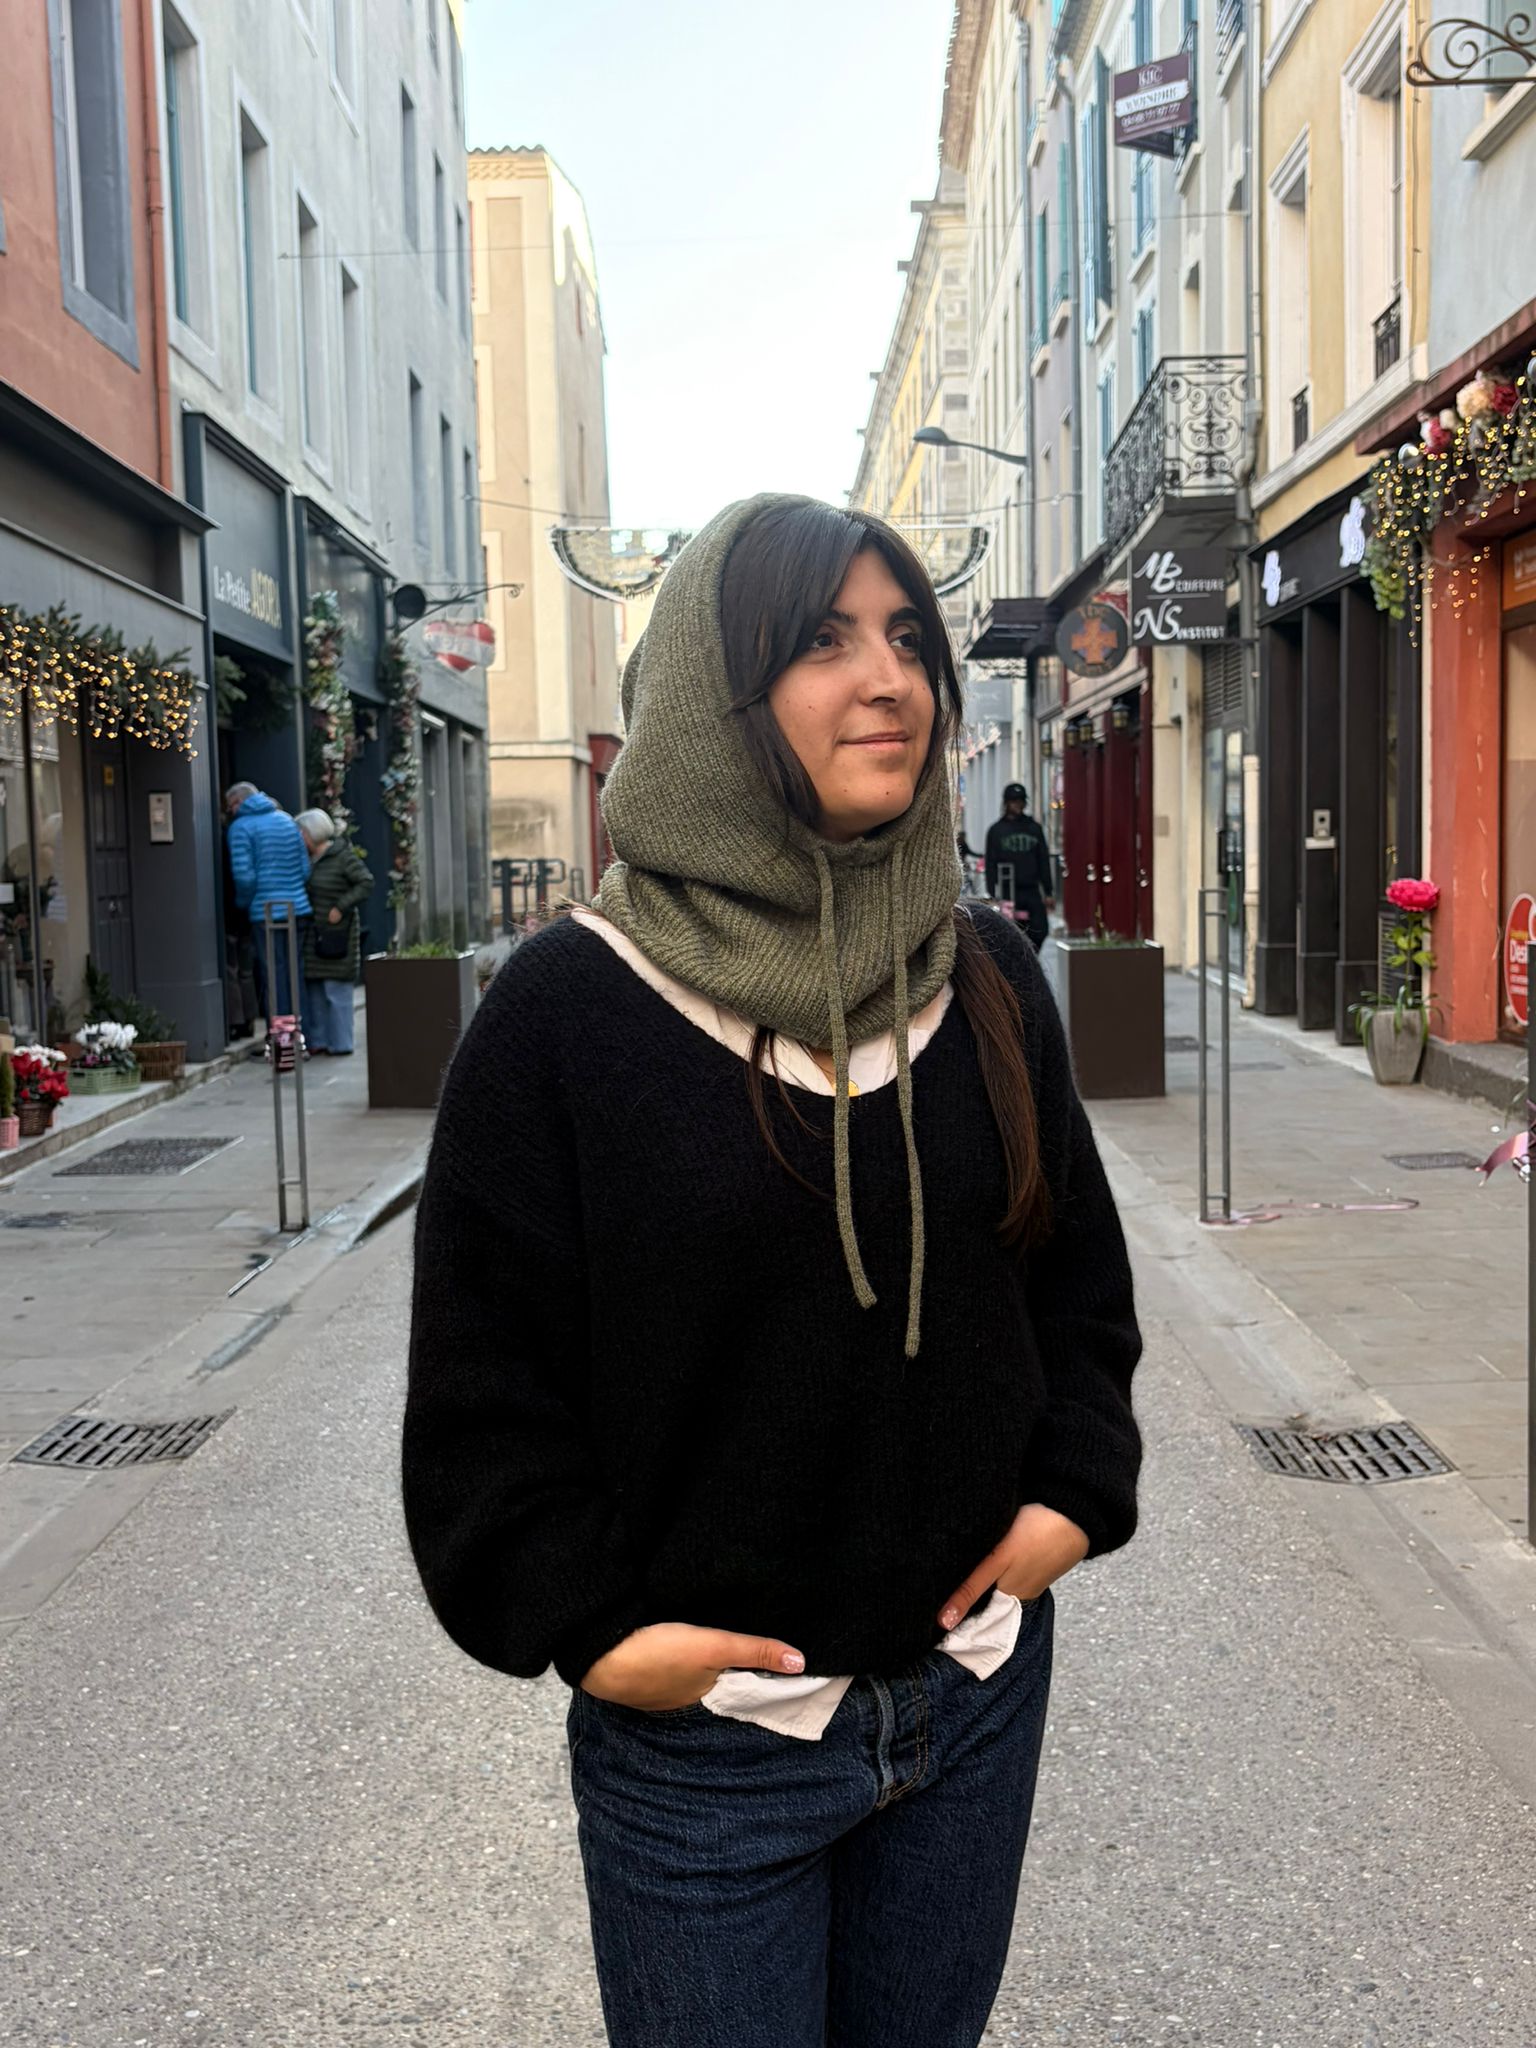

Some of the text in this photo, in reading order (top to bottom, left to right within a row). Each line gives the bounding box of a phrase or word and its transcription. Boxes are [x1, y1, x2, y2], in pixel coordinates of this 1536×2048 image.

[213, 566, 225, 601] La
[225, 570, 250, 614] Petite
[1133, 551, 1225, 593] MB COIFFURE
[1133, 598, 1225, 641] NS INSTITUT
